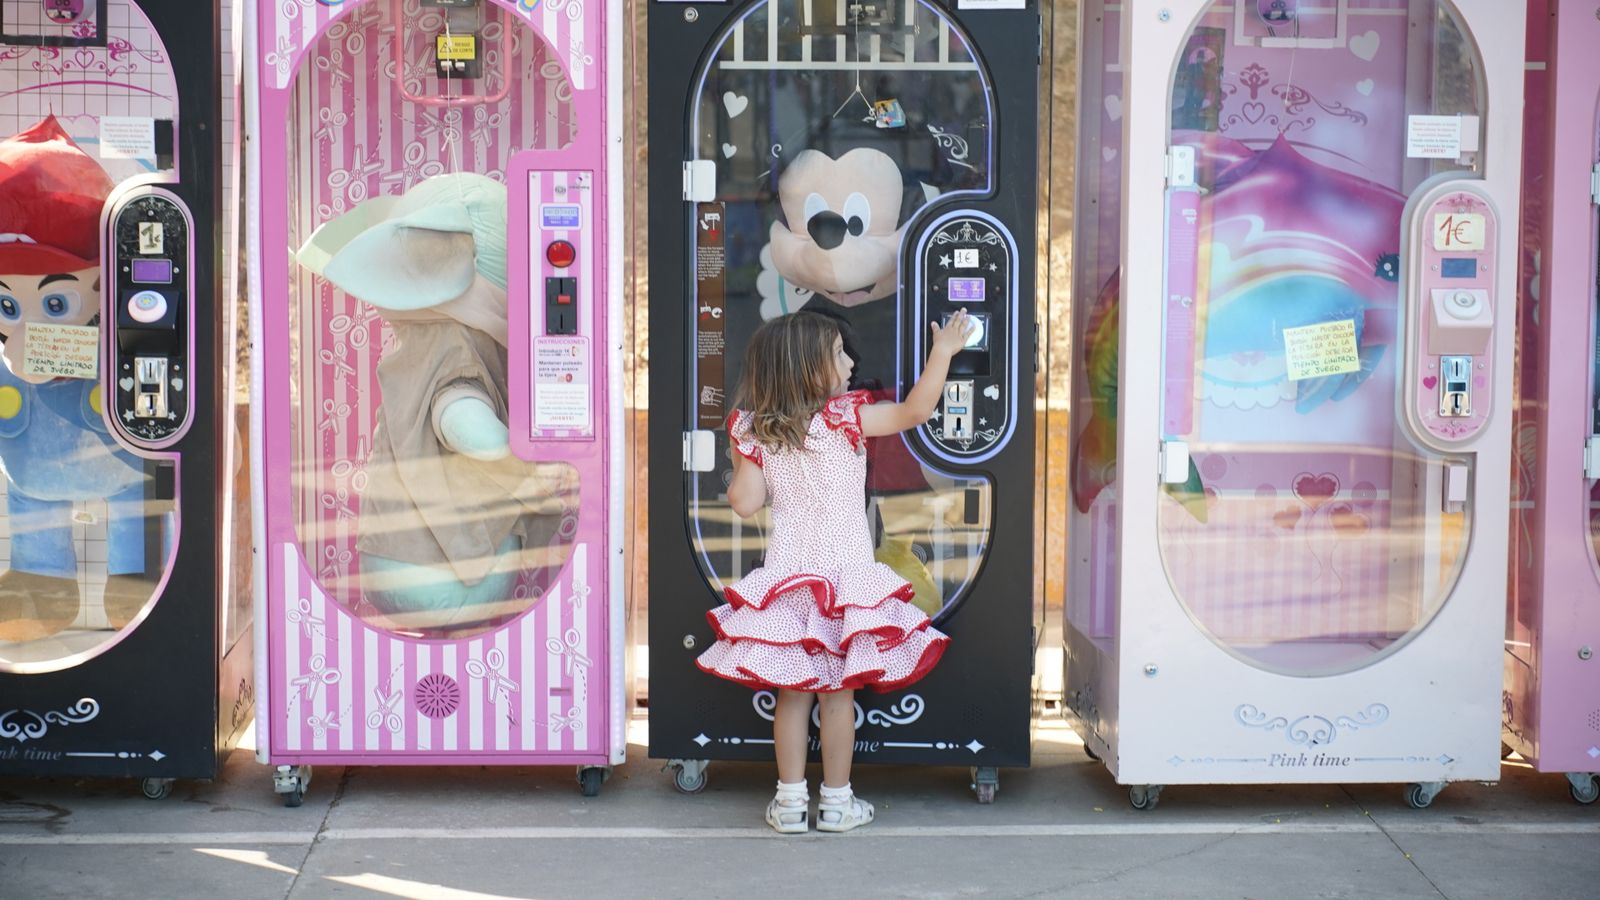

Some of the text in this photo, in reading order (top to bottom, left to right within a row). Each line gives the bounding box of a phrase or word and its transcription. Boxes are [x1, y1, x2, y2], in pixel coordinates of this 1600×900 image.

[1440, 216, 1472, 246] 1€
[957, 252, 972, 264] 1€
[60, 361, 92, 370] LIMITADO
[1324, 356, 1356, 364] LIMITADO
[854, 741, 879, 752] me
[24, 747, 62, 760] time
[1268, 752, 1350, 767] Pink time
